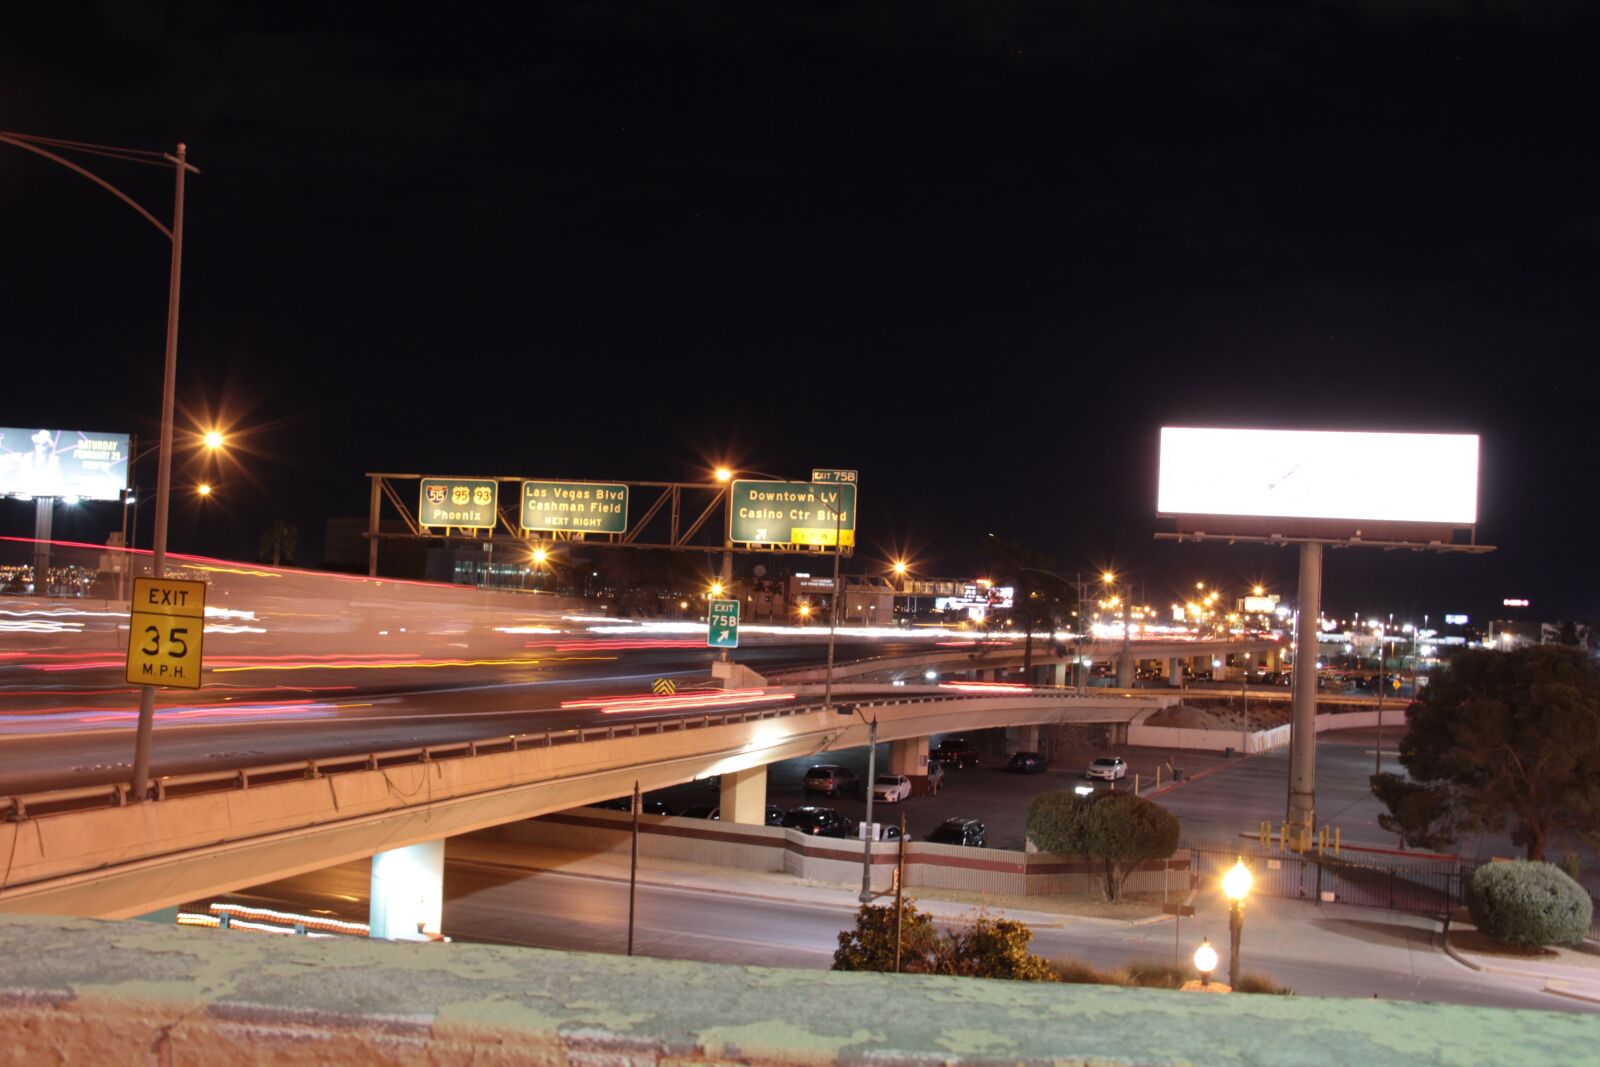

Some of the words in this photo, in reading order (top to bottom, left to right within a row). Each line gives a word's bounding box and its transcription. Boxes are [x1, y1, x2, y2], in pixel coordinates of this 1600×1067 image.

[78, 439, 118, 450] SATURDAY
[814, 472, 832, 480] EXIT
[833, 471, 855, 481] 75B
[429, 490, 445, 501] 515
[454, 490, 469, 501] 95
[476, 491, 490, 501] 93
[526, 486, 547, 498] Las
[554, 487, 590, 501] Vegas
[596, 489, 625, 501] Blvd
[749, 489, 815, 503] Downtown
[820, 491, 838, 503] LV
[528, 499, 585, 513] Cashman
[590, 502, 621, 514] Field
[433, 509, 482, 521] Phoenix
[739, 507, 783, 520] Casino
[789, 508, 811, 520] Ctr
[817, 510, 847, 522] Blvd
[544, 516, 570, 526] NEXT
[573, 517, 603, 527] RIGHT
[149, 588, 189, 606] EXIT
[714, 604, 734, 613] EXIT
[711, 615, 737, 627] 75B
[142, 625, 188, 658] 35
[142, 663, 187, 679] M.P.H.
